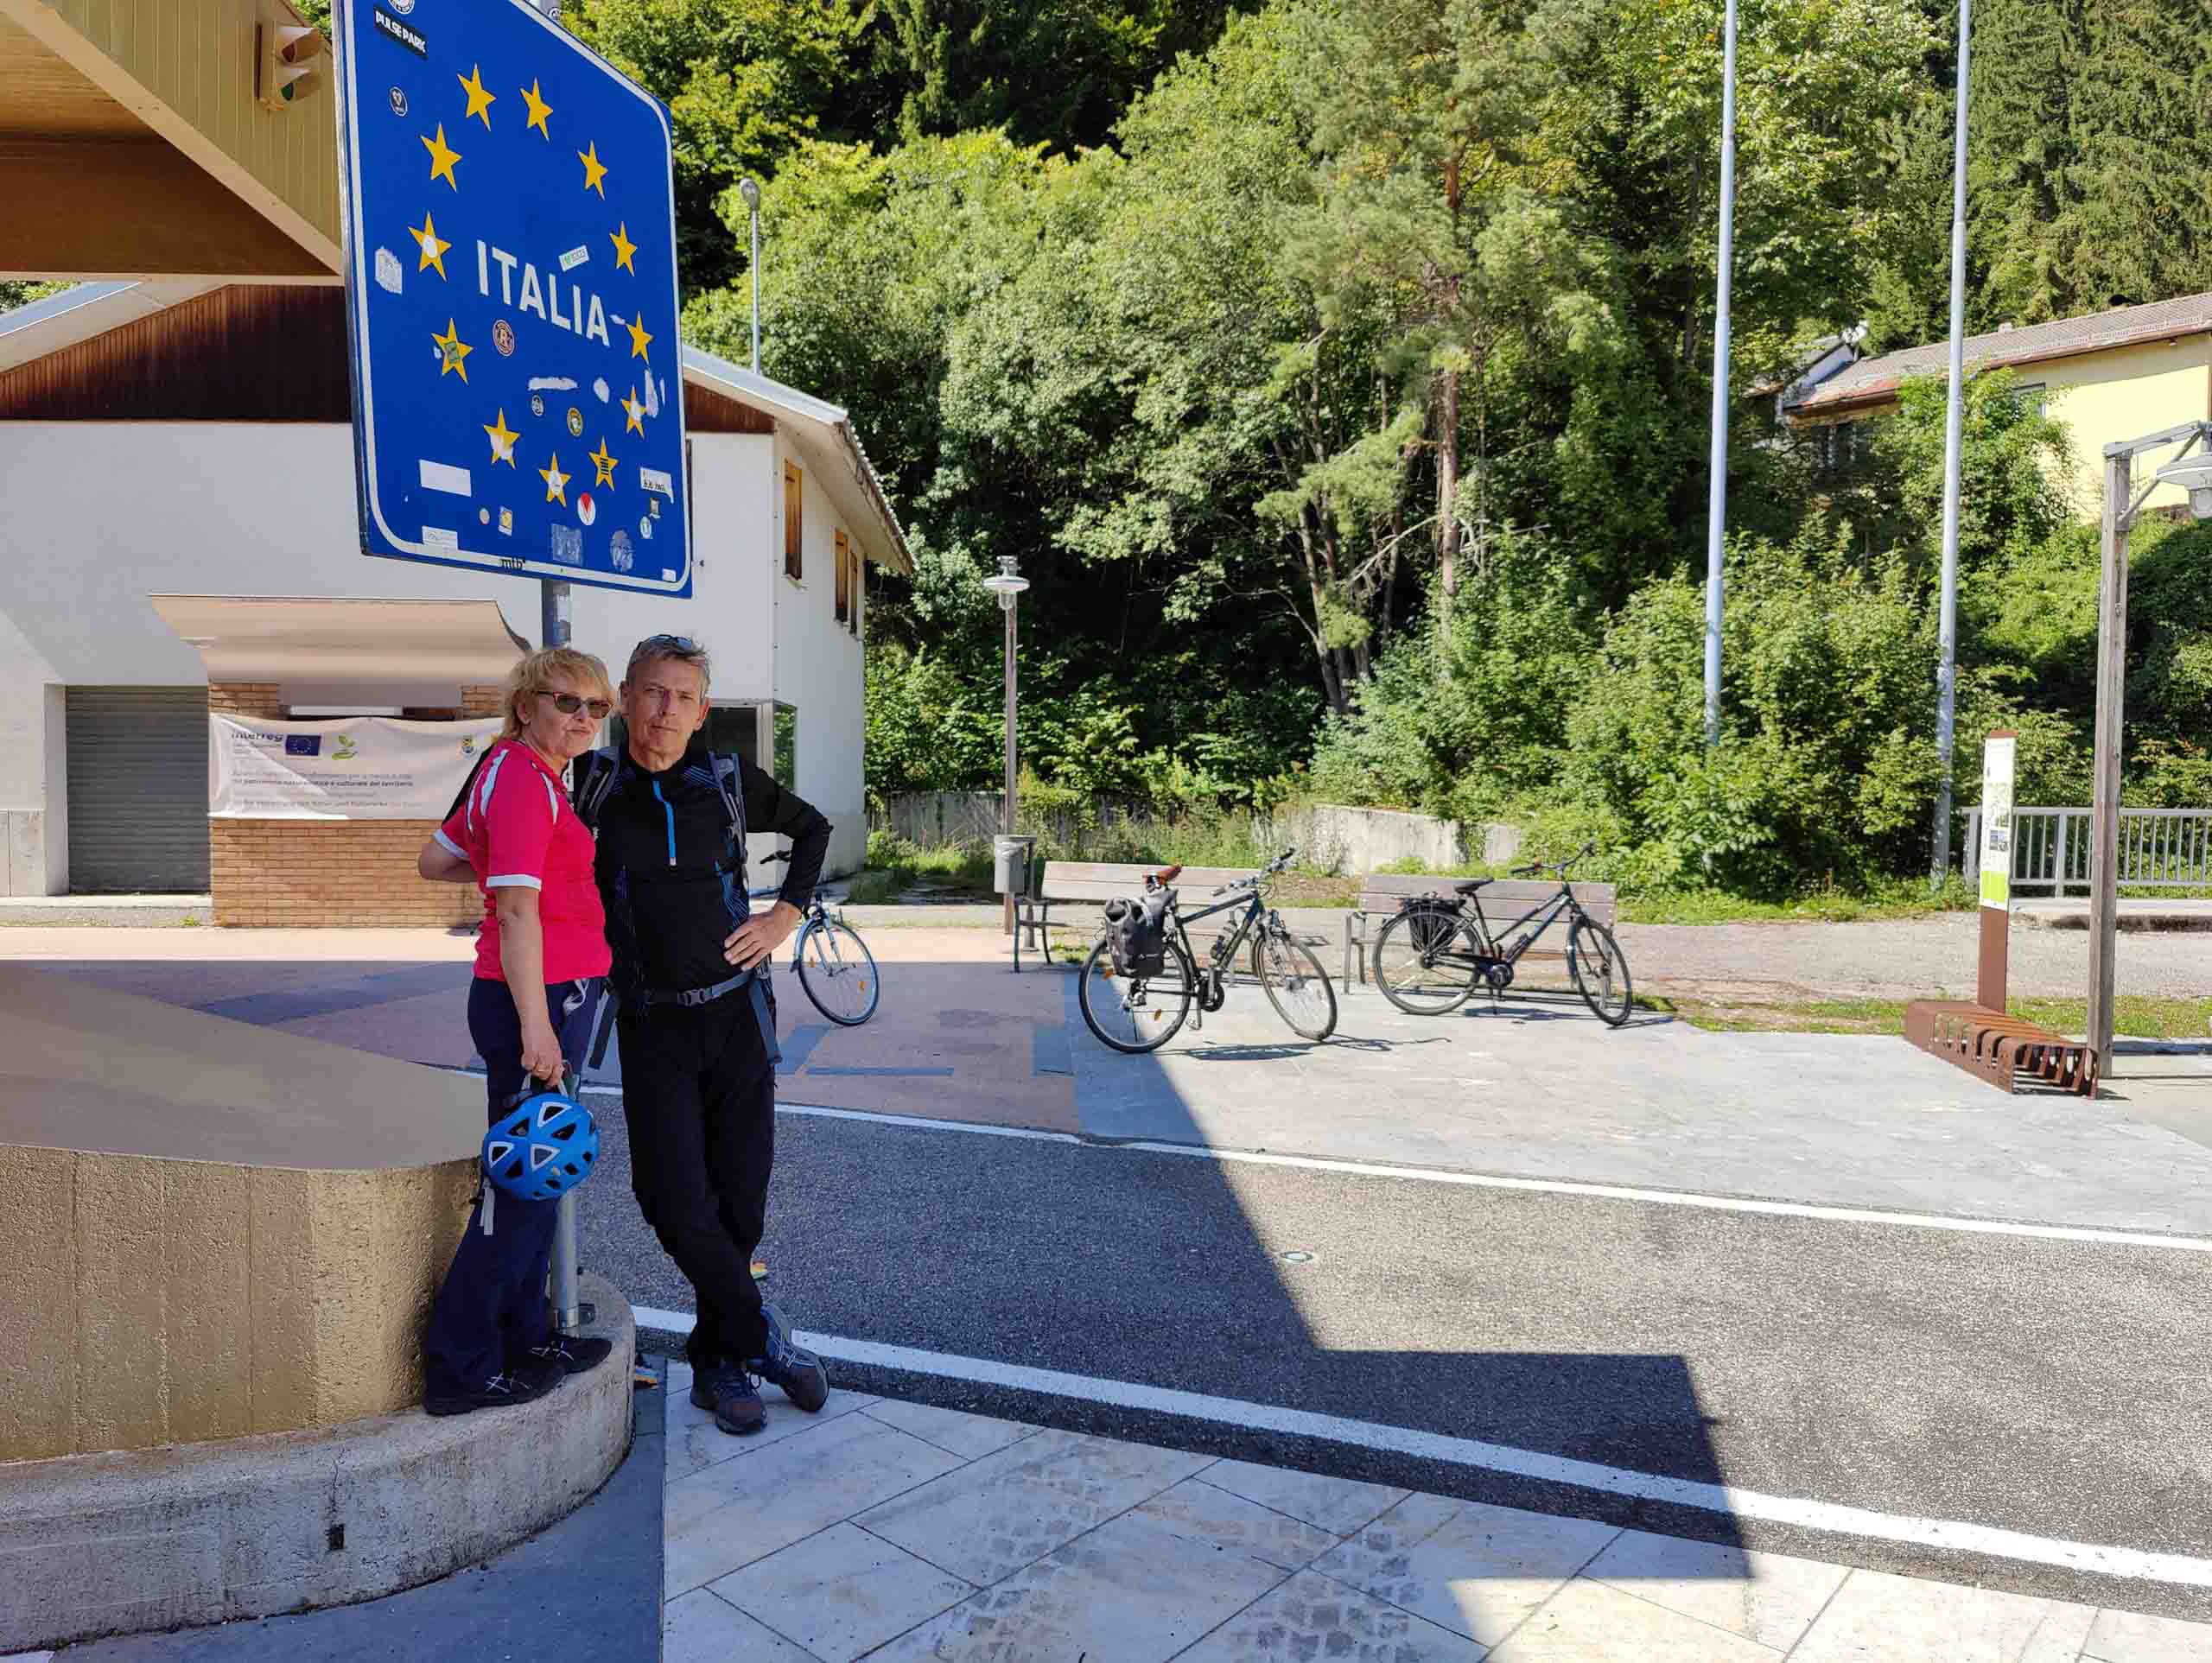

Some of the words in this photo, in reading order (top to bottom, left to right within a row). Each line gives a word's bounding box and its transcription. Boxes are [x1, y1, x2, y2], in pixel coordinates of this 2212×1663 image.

[375, 10, 402, 37] PULSE
[402, 27, 426, 53] PARK
[476, 238, 610, 347] ITALIA
